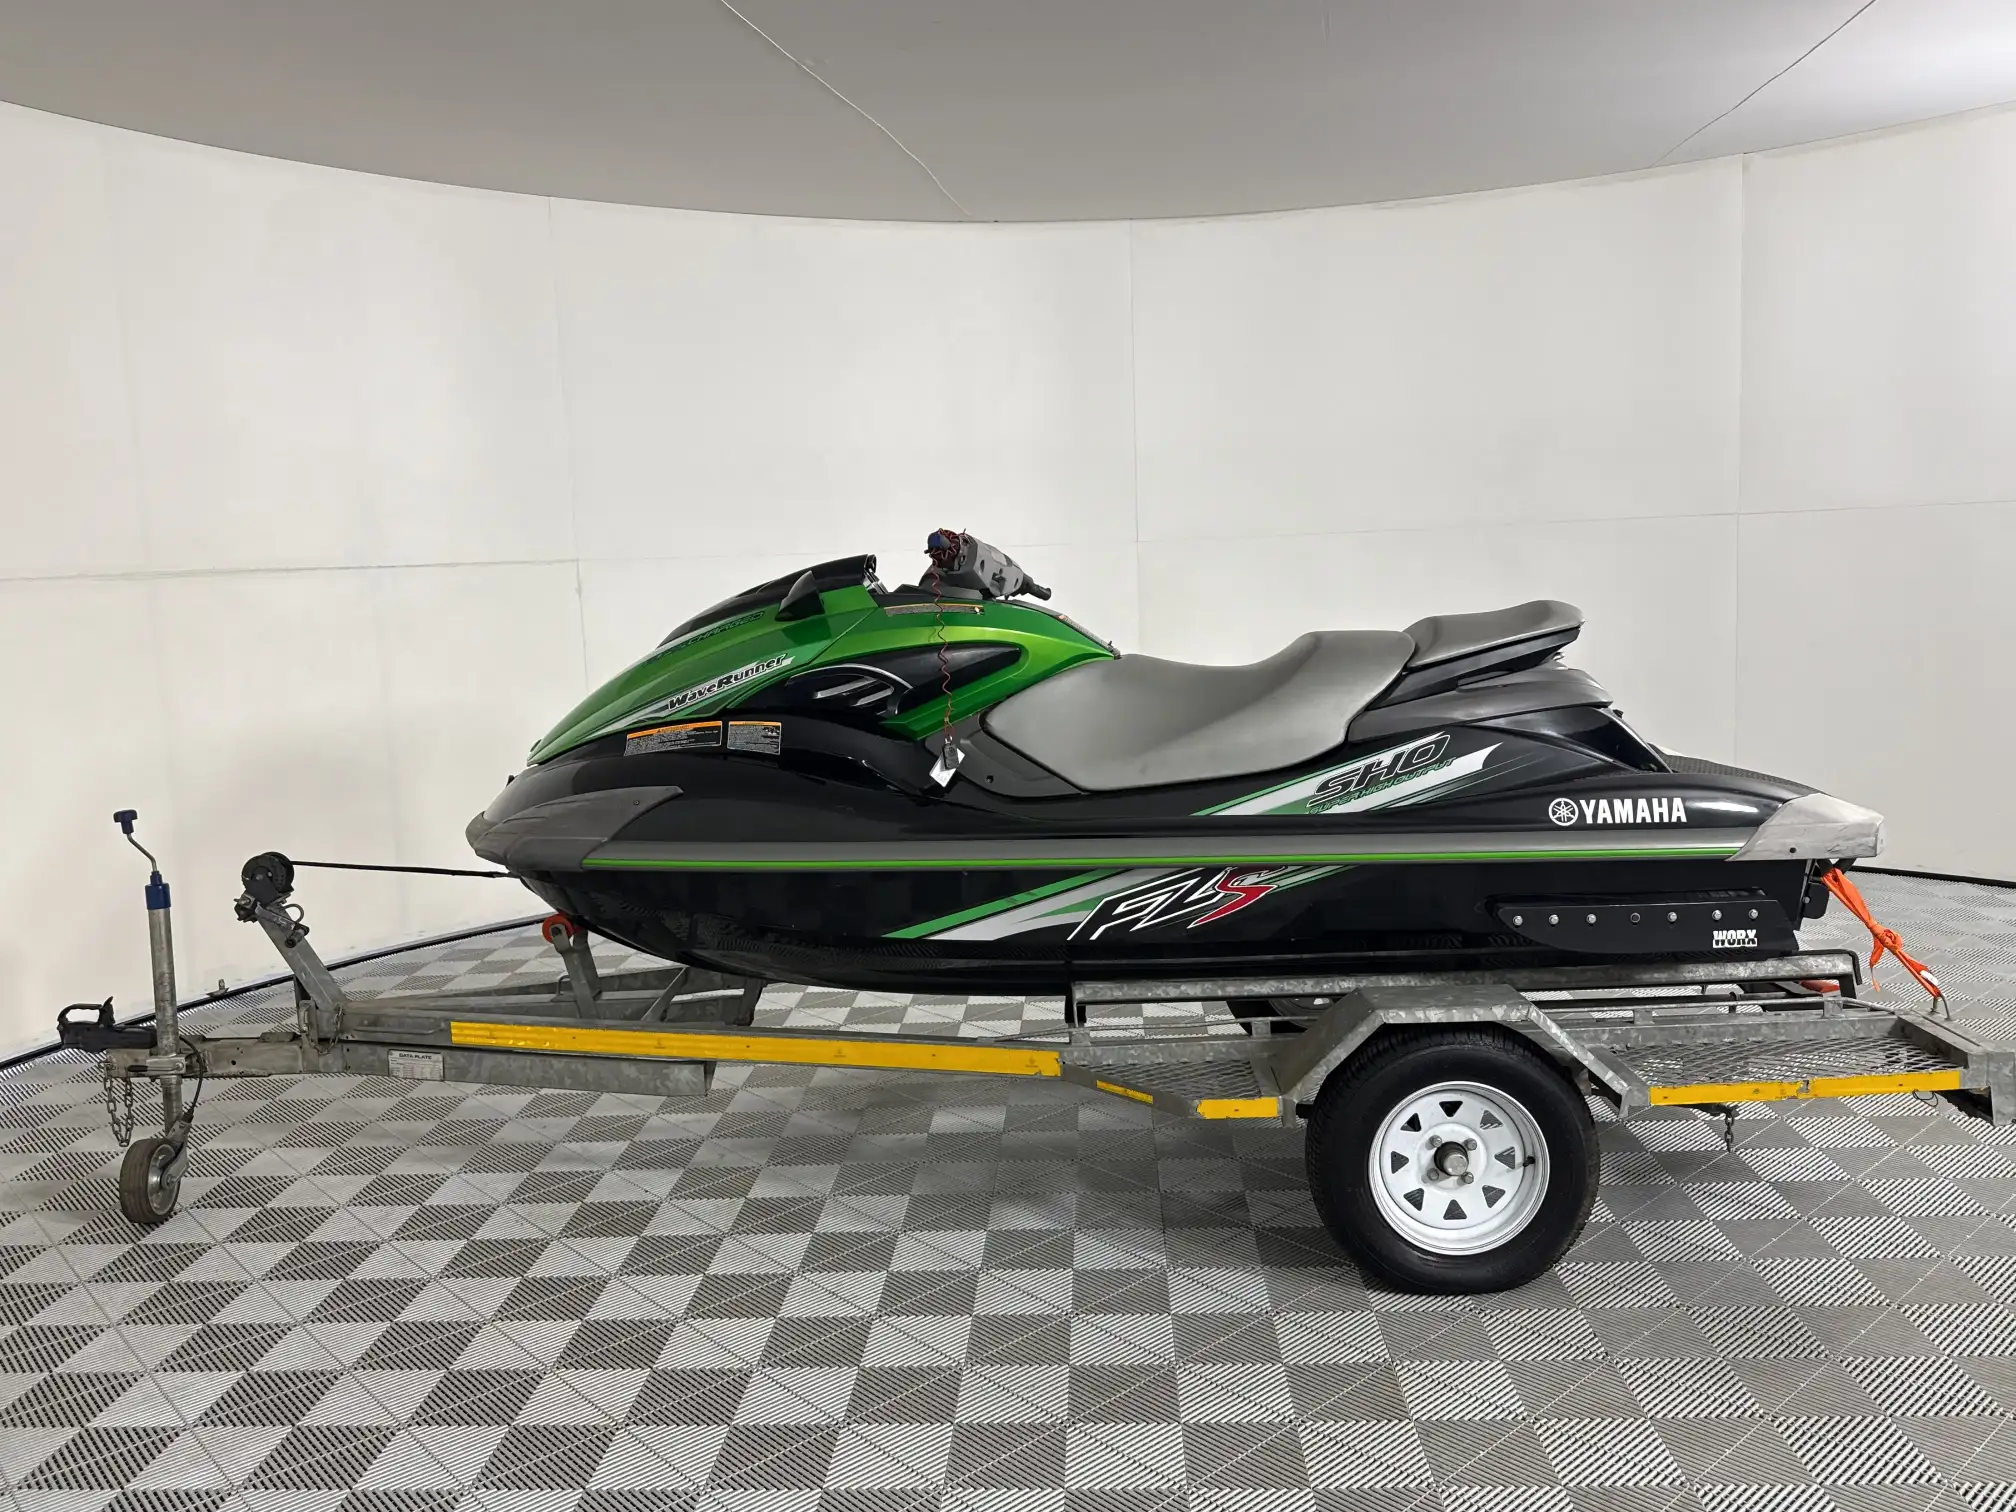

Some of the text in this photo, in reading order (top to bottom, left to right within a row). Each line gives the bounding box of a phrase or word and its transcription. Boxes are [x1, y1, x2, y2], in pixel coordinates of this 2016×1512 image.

[667, 653, 788, 711] WaveRunner
[1306, 734, 1451, 808] SHO
[1309, 757, 1457, 815] SUPER HIGH OUTPUT
[1579, 797, 1687, 824] YAMAHA
[1712, 929, 1758, 949] WORX
